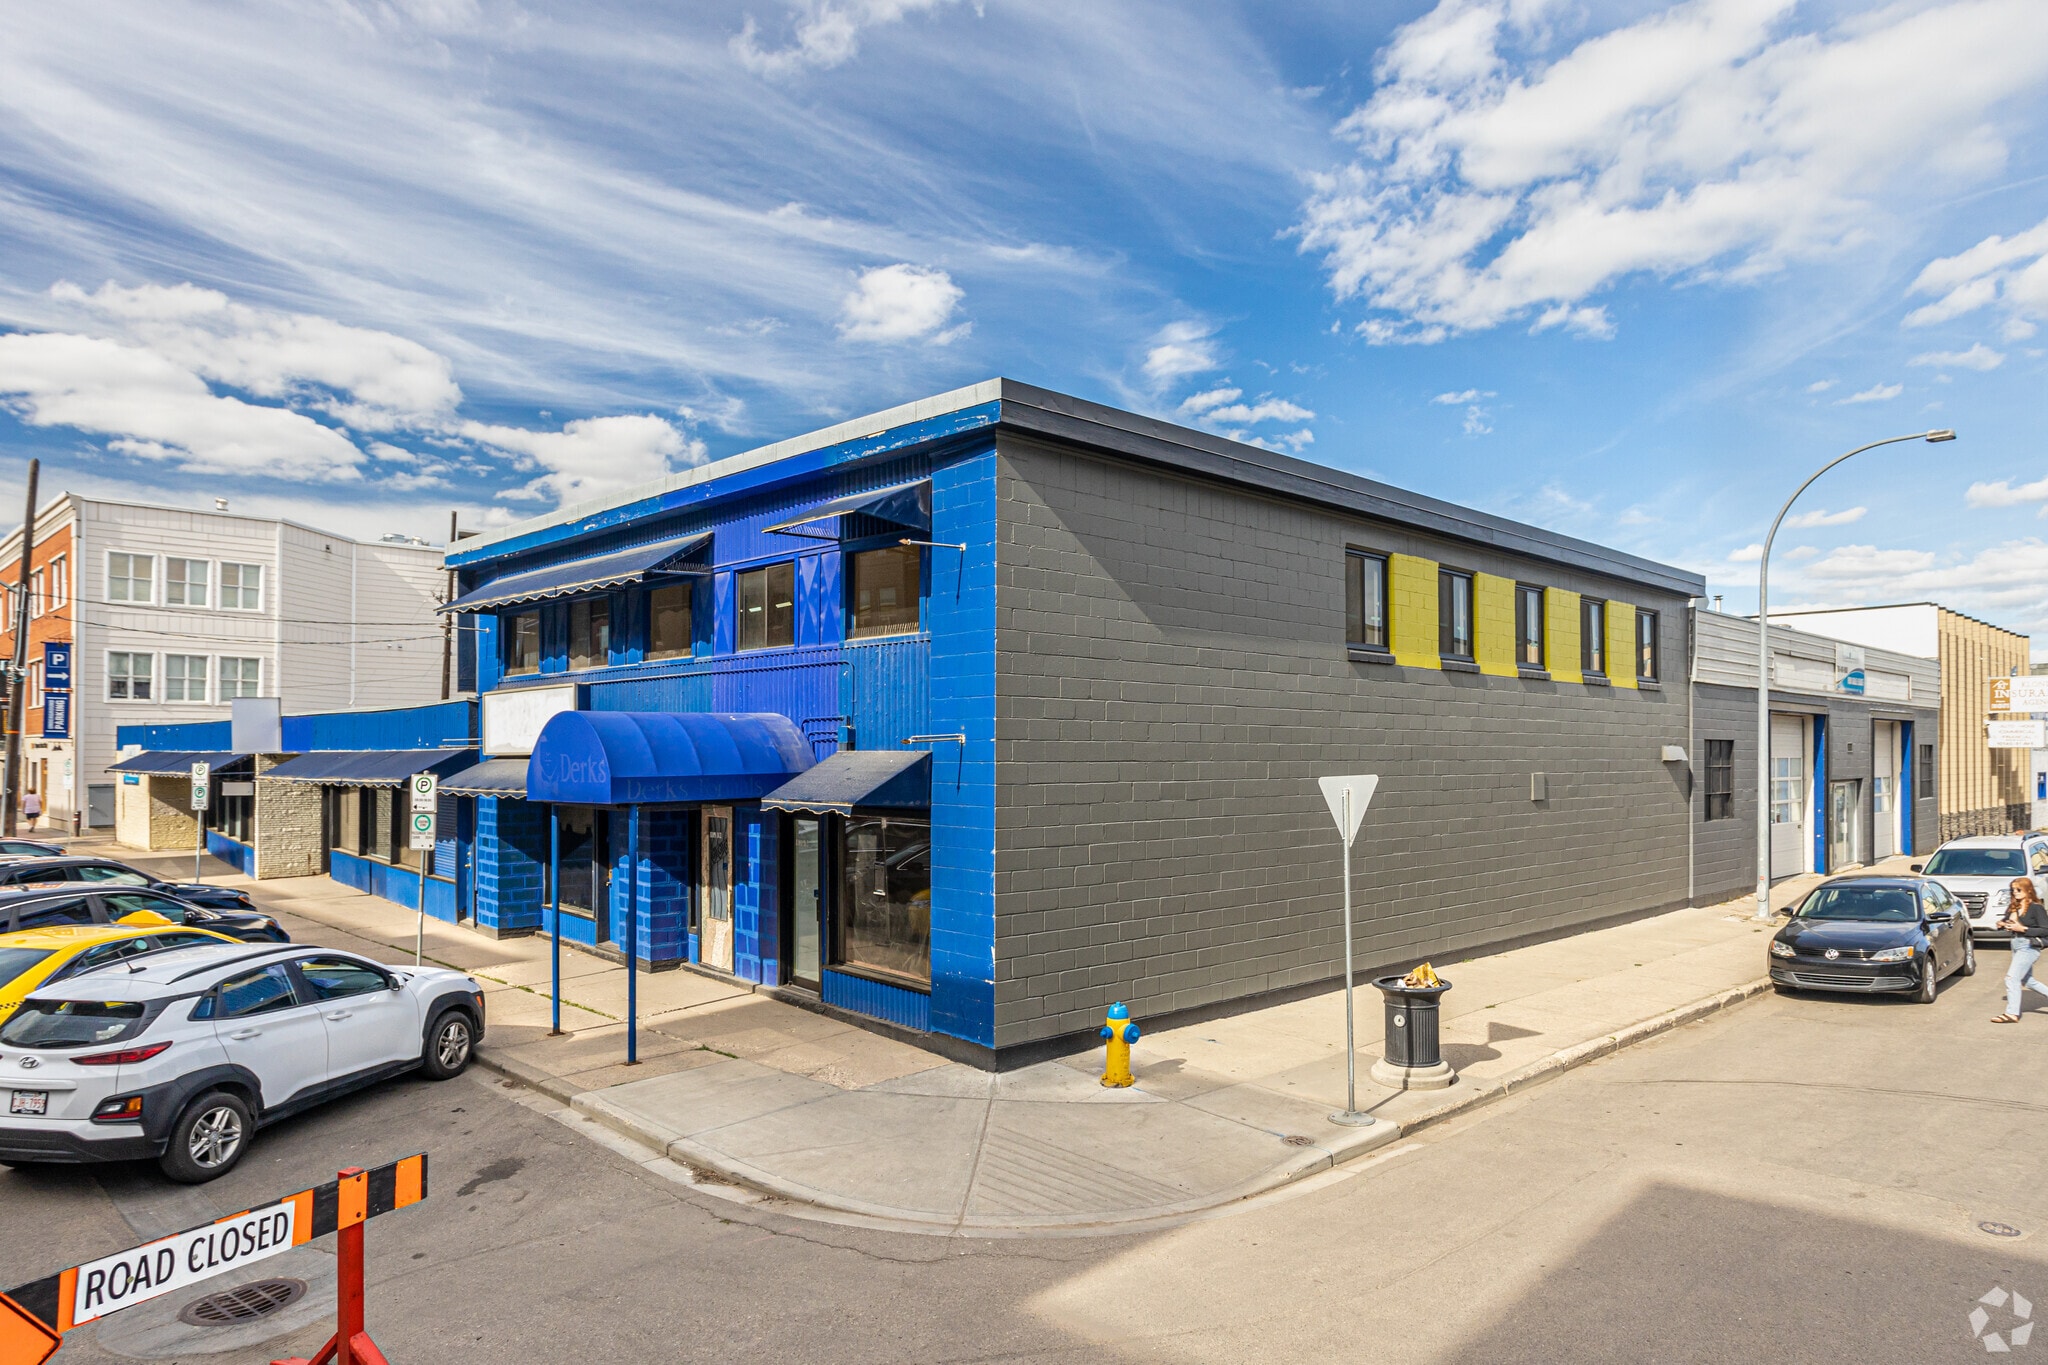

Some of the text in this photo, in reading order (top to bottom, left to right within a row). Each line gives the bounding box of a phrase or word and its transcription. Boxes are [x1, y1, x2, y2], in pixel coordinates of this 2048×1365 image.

[52, 654, 65, 665] P
[1994, 689, 2048, 698] INSURA
[54, 699, 66, 730] PARKING
[560, 753, 607, 784] Derks
[420, 780, 429, 790] P
[626, 778, 689, 800] Derks
[84, 1211, 289, 1310] ROAD CLOSED
